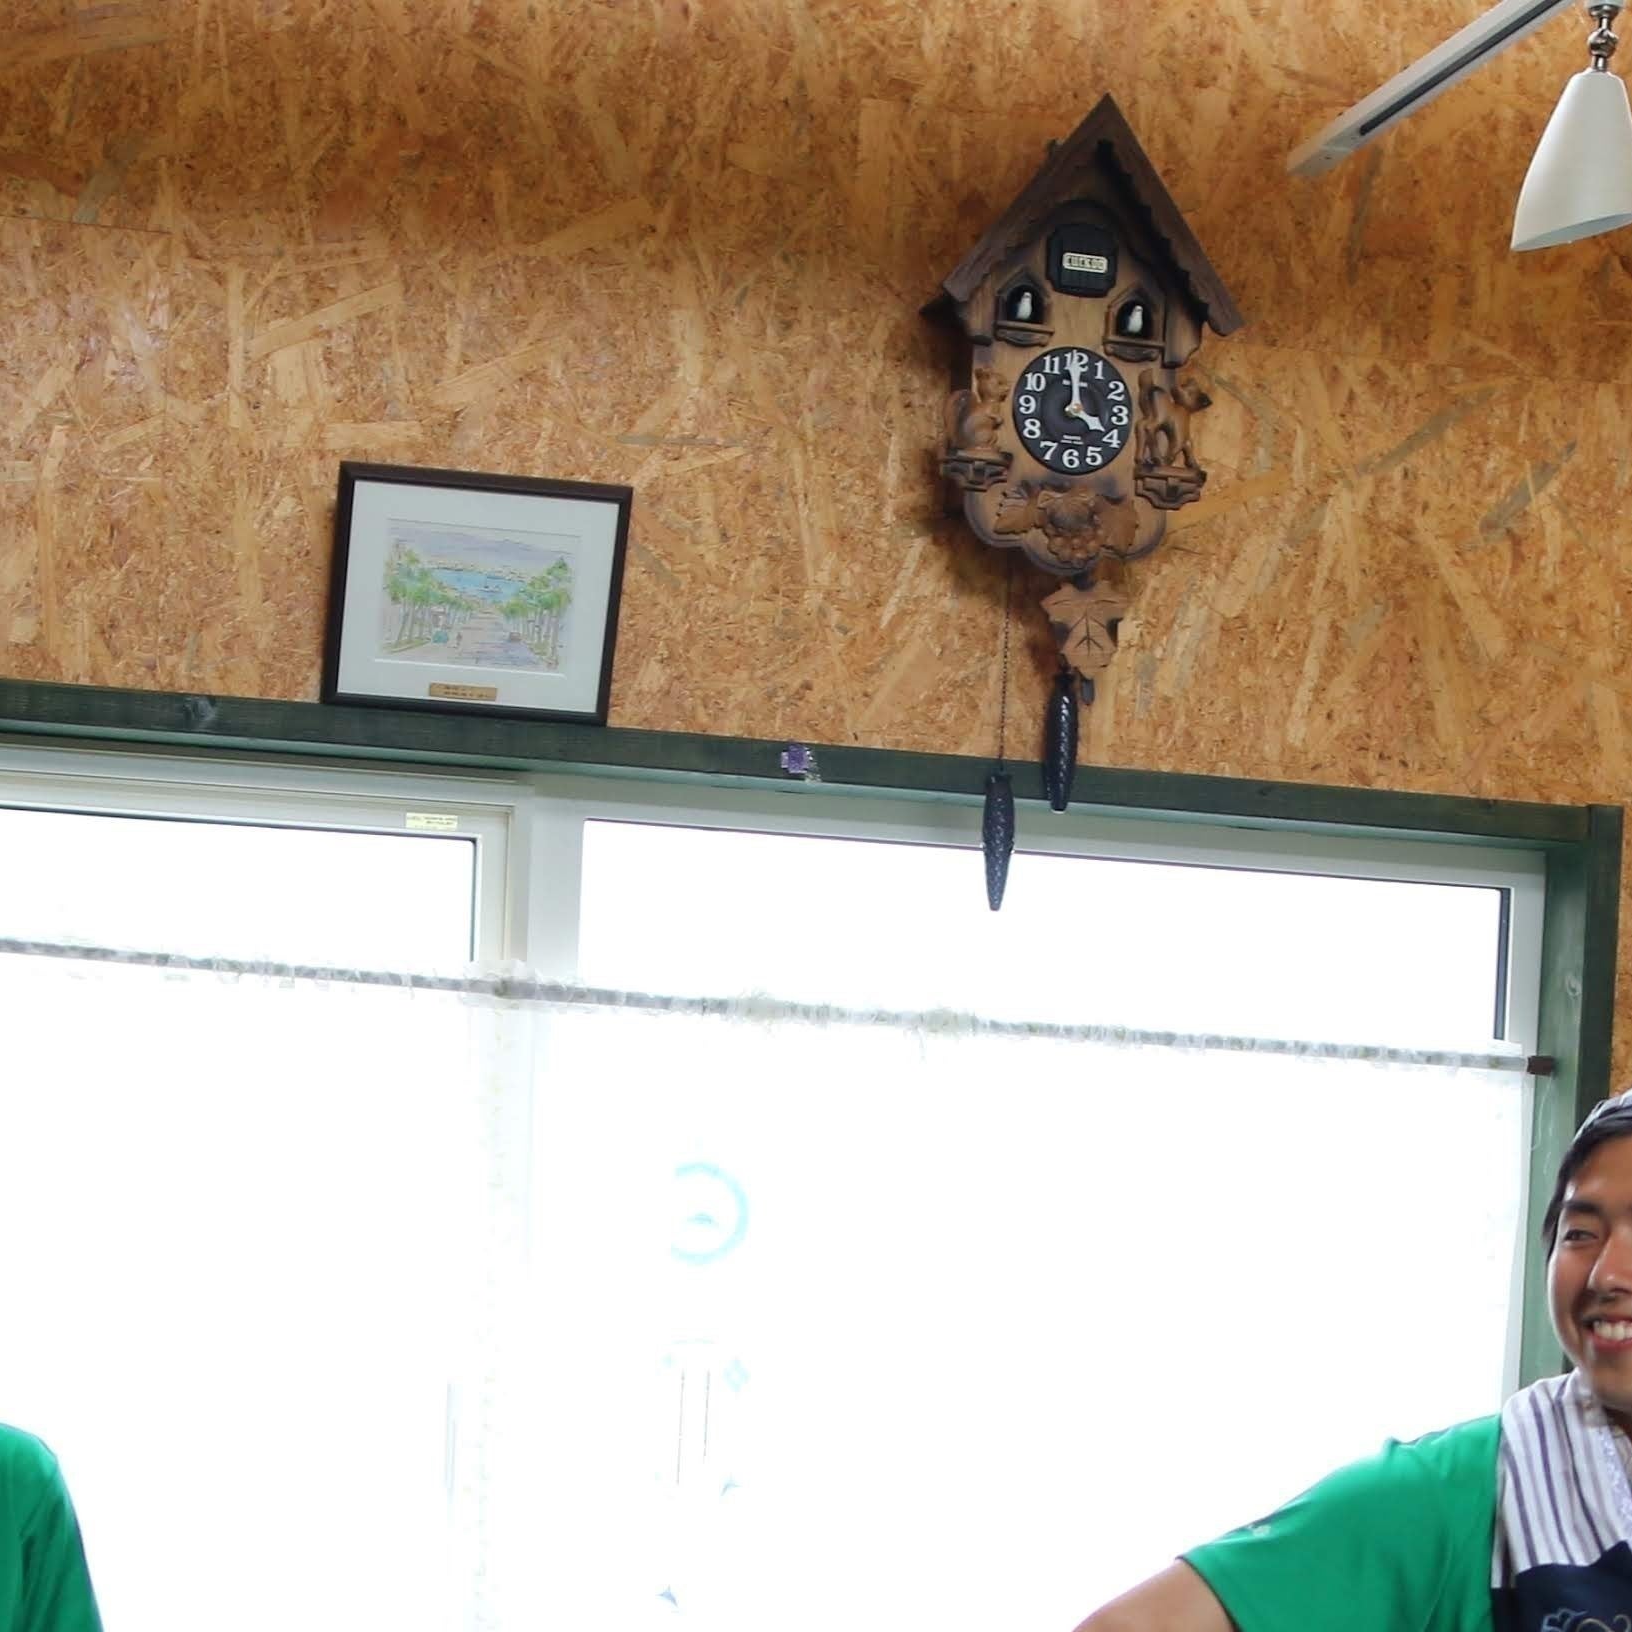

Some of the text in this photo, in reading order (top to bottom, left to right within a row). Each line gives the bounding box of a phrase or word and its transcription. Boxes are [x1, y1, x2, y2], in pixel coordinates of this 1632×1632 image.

[1043, 355, 1061, 375] 11
[1064, 353, 1088, 371] 12
[1094, 361, 1104, 379] 1
[1025, 372, 1046, 392] 10
[1107, 380, 1125, 401] 2
[1019, 395, 1036, 415] 9
[1111, 405, 1128, 425] 3
[1023, 418, 1041, 439] 8
[1102, 428, 1121, 449] 4
[1039, 441, 1058, 461] 7
[1062, 448, 1080, 469] 6
[1085, 446, 1103, 466] 5
